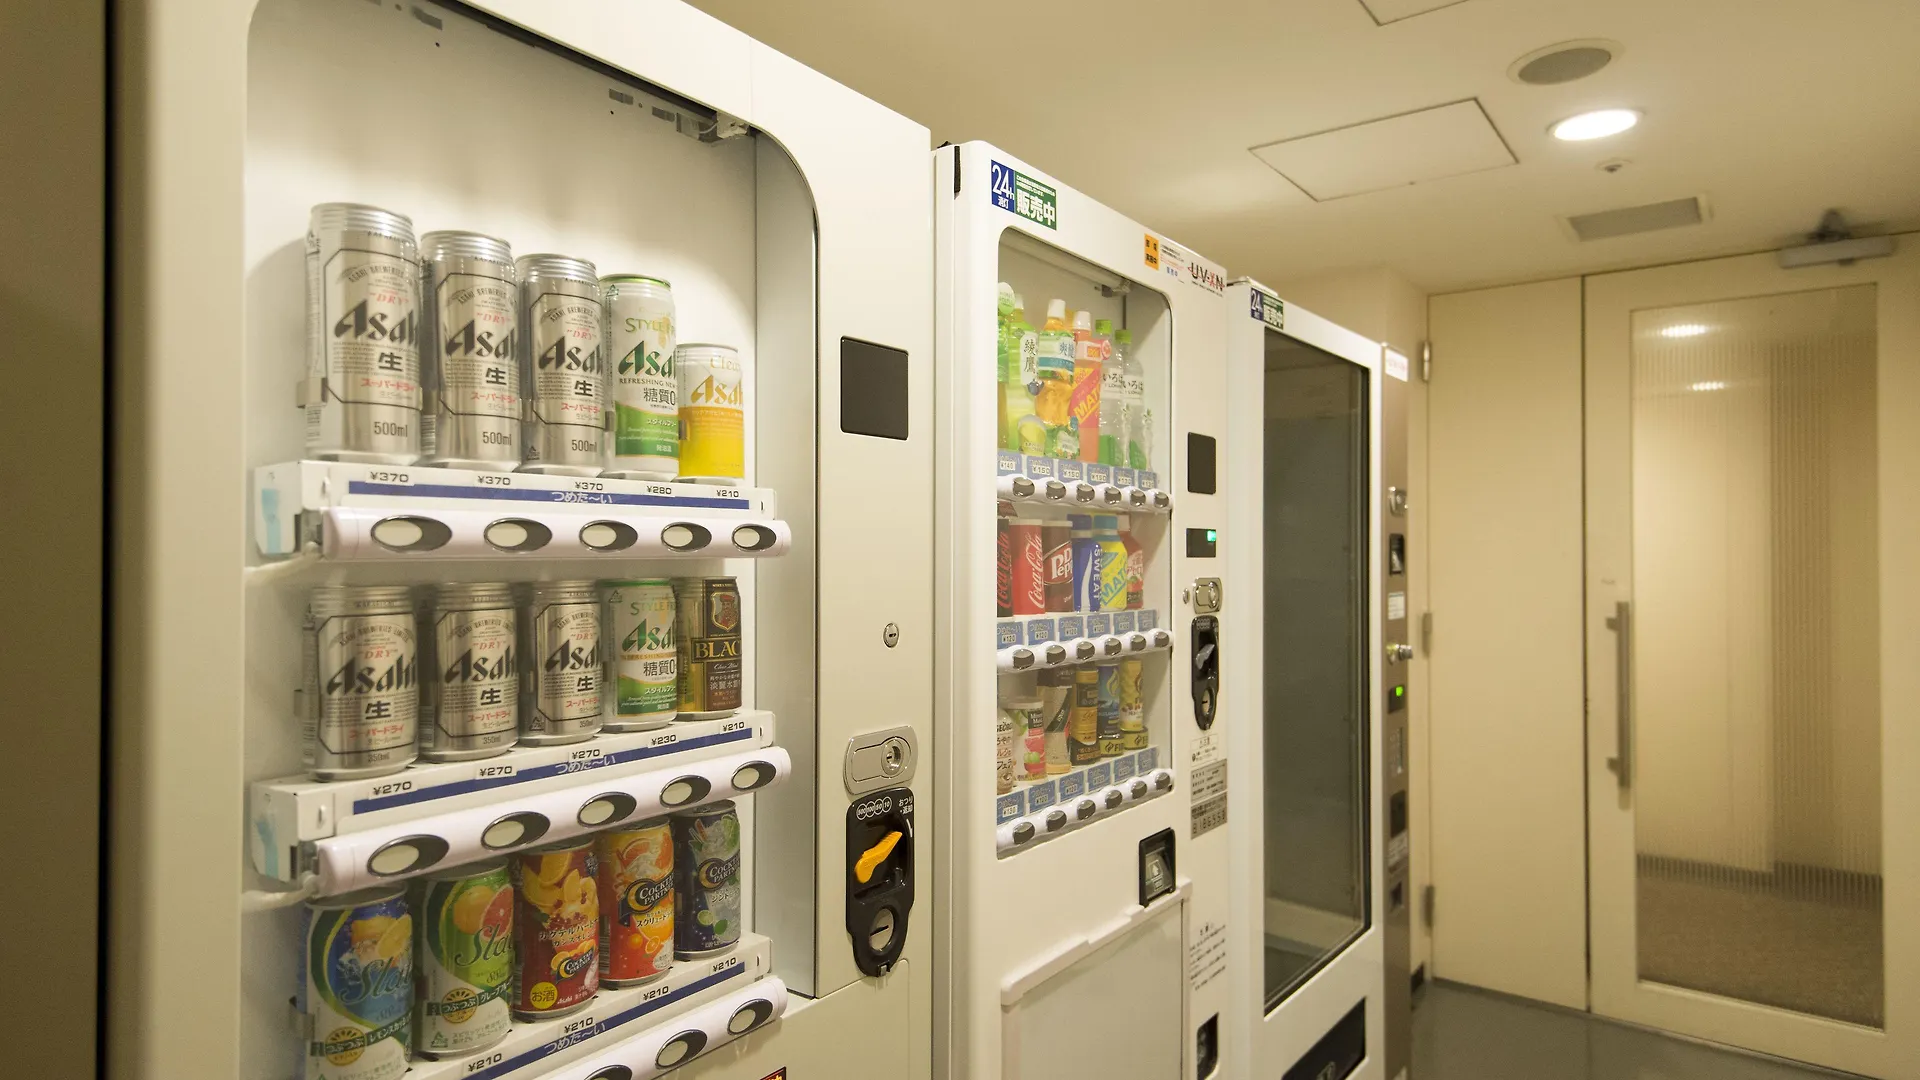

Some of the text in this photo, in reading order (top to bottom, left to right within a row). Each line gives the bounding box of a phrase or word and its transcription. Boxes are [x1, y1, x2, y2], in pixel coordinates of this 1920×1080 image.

[1016, 188, 1055, 226] 販売中
[378, 352, 403, 372] 生
[617, 340, 677, 380] Asa
[1024, 338, 1037, 374] 綾鷹
[485, 367, 508, 386] 生
[619, 378, 664, 387] REFRESHING
[574, 380, 594, 397] 生
[643, 387, 676, 406] 糖質0
[1073, 384, 1100, 418] MAT
[374, 421, 408, 438] 500ml
[482, 431, 512, 446] 500ml
[571, 439, 597, 452] 500ml
[369, 472, 409, 484] ¥370
[477, 475, 511, 486] ¥370
[574, 481, 603, 492] ¥370
[646, 485, 672, 495] ¥280
[716, 489, 739, 498] ¥210
[1093, 548, 1102, 601] SWEAT
[1101, 560, 1127, 602] MAT
[621, 618, 677, 652] Asa
[544, 638, 601, 673] Asah
[643, 659, 676, 677] 糖質0
[576, 675, 594, 692] 生
[480, 688, 502, 706] 生
[365, 700, 391, 720] 生
[722, 721, 745, 732] ¥210
[651, 734, 677, 746] ¥230
[572, 749, 601, 759] ¥270
[479, 766, 513, 777] ¥270
[373, 781, 412, 796] ¥270
[709, 856, 740, 878] COCKT
[712, 957, 737, 972] ¥210
[531, 990, 555, 1003] お酒
[643, 986, 669, 1001] ¥210
[441, 998, 477, 1013] つぶつぶ
[564, 1017, 594, 1034] ¥210
[468, 1053, 502, 1072] ¥210
